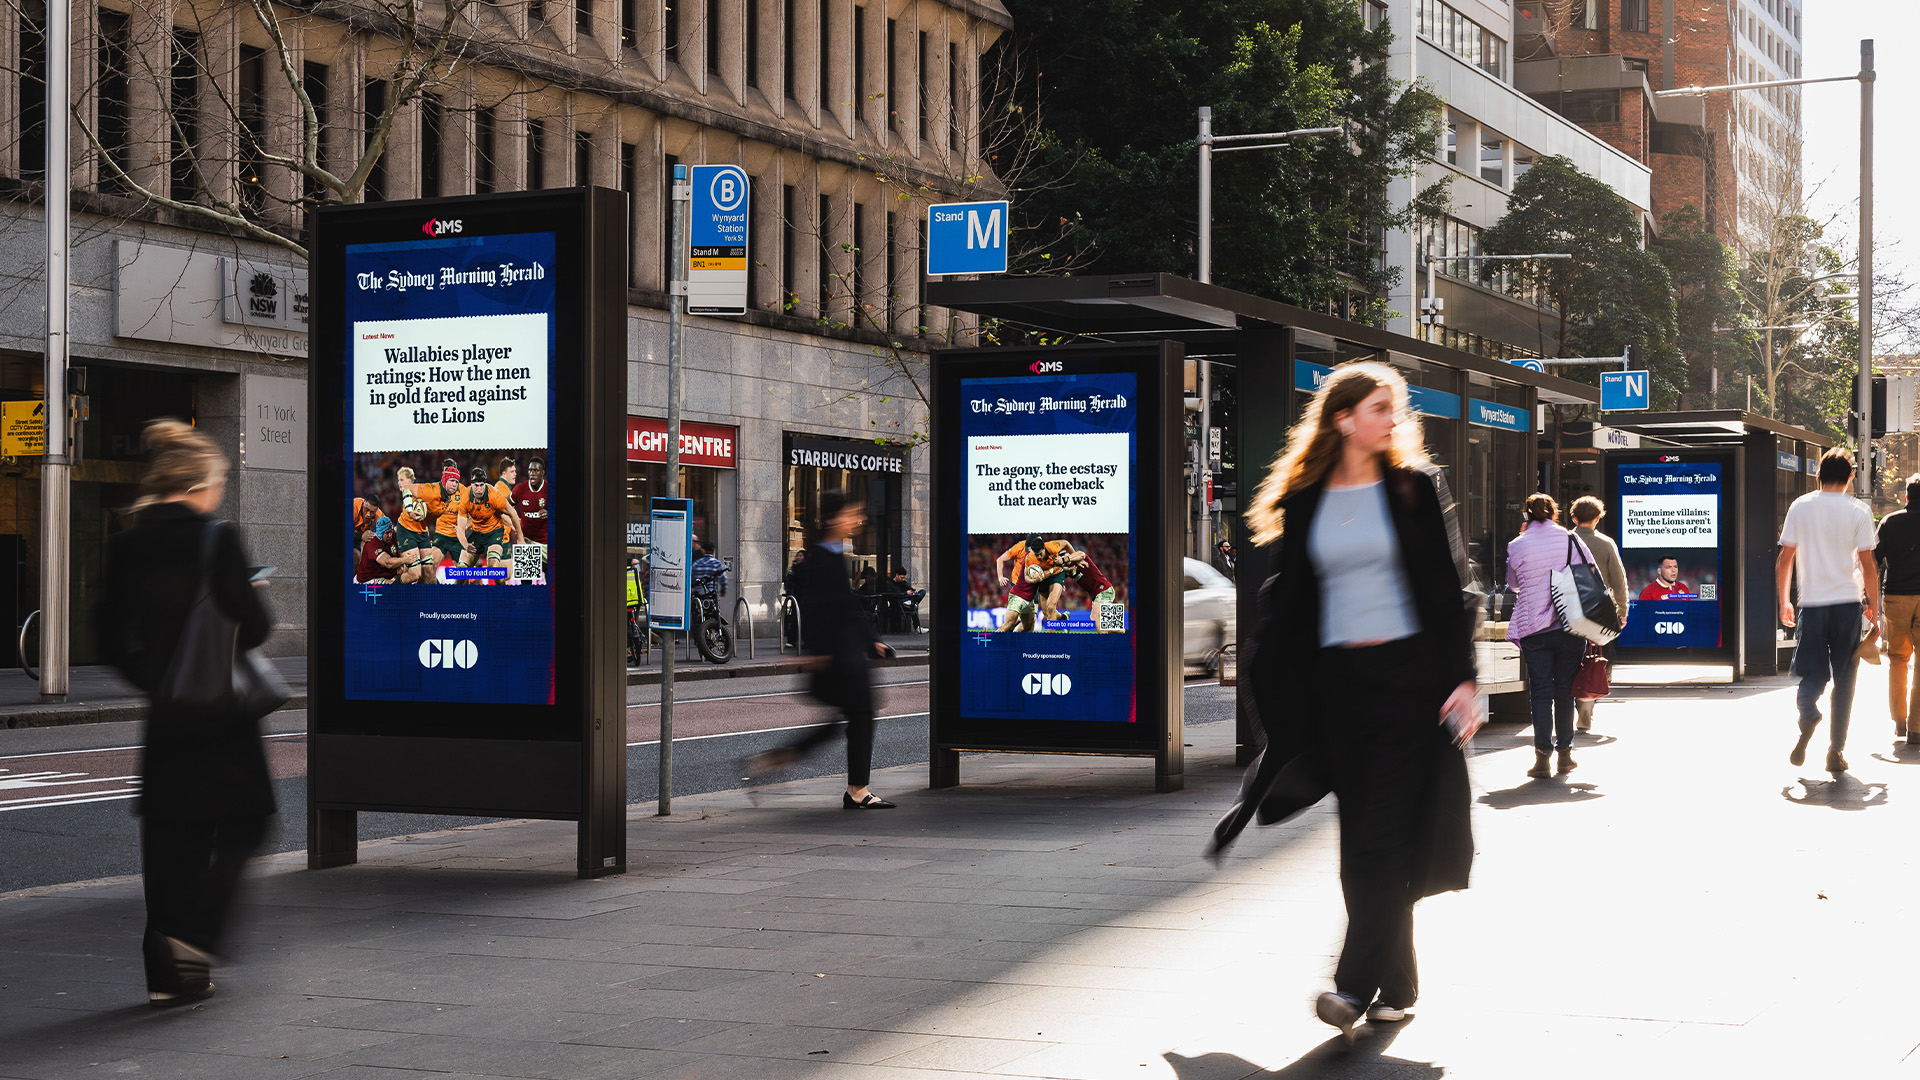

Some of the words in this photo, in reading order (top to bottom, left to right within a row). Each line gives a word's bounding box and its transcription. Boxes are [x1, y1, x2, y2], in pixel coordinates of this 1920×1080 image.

[721, 179, 735, 202] B
[711, 213, 745, 223] Wynyard
[427, 218, 463, 237] QMS
[717, 224, 744, 233] Station
[934, 210, 964, 222] Stand
[967, 208, 1001, 250] M
[692, 248, 712, 256] Stand
[712, 248, 719, 256] M
[692, 260, 706, 268] BN1
[356, 271, 384, 293] The
[385, 269, 435, 292] Sydney
[439, 266, 497, 291] Morning
[499, 261, 545, 288] Herald
[250, 297, 277, 314] NSW
[250, 312, 277, 320] GOVERNMENT
[243, 330, 289, 351] Wynyard
[384, 345, 459, 364] Wallabies
[461, 344, 513, 365] player
[1032, 360, 1063, 374] QMS
[366, 368, 426, 387] ratings:
[428, 366, 464, 383] How
[467, 365, 493, 381] the
[495, 366, 531, 380] men
[1604, 375, 1623, 383] Stand
[1625, 374, 1643, 397] N
[369, 389, 386, 405] in
[388, 387, 421, 409] gold
[424, 385, 466, 404] fared
[469, 385, 527, 406] against
[970, 398, 993, 415] The
[994, 397, 1036, 415] Sydney
[1039, 396, 1087, 414] Morning
[1089, 394, 1127, 413] Herald
[257, 404, 269, 420] 11
[273, 404, 296, 422] York
[413, 408, 439, 424] the
[441, 407, 485, 424] Lions
[1480, 405, 1500, 423] Wynyard
[1499, 409, 1516, 425] Station
[260, 426, 292, 444] Street
[678, 434, 732, 458] CENTRE
[791, 448, 859, 470] STARBUCKS
[860, 454, 902, 473] COFFEE
[975, 463, 1001, 477] The
[1002, 464, 1043, 479] agony,
[1045, 462, 1068, 475] the
[1069, 462, 1118, 477] ecstasy
[1623, 475, 1638, 484] The
[1638, 474, 1663, 485] Sydney
[1664, 474, 1693, 484] Morning
[1693, 473, 1717, 484] Herald
[988, 478, 1013, 491] and
[1014, 478, 1037, 491] the
[1038, 477, 1105, 491] comeback
[998, 493, 1026, 507] that
[1028, 493, 1070, 509] nearly
[1072, 495, 1098, 506] was
[1628, 509, 1676, 517] Pantomime
[1676, 508, 1710, 516] villains:
[627, 523, 650, 534] LIGHT
[1627, 517, 1646, 527] Why
[1647, 517, 1661, 525] the
[1662, 517, 1686, 525] Lions
[1688, 526, 1698, 534] of
[448, 568, 465, 577] Scan
[473, 569, 488, 577] read
[488, 569, 506, 577] more
[419, 612, 441, 620] Proudly
[441, 612, 470, 620] sponsored
[470, 612, 478, 621] by
[1654, 621, 1685, 634] GIO
[418, 639, 478, 669] GIO
[1021, 672, 1072, 696] GIO
